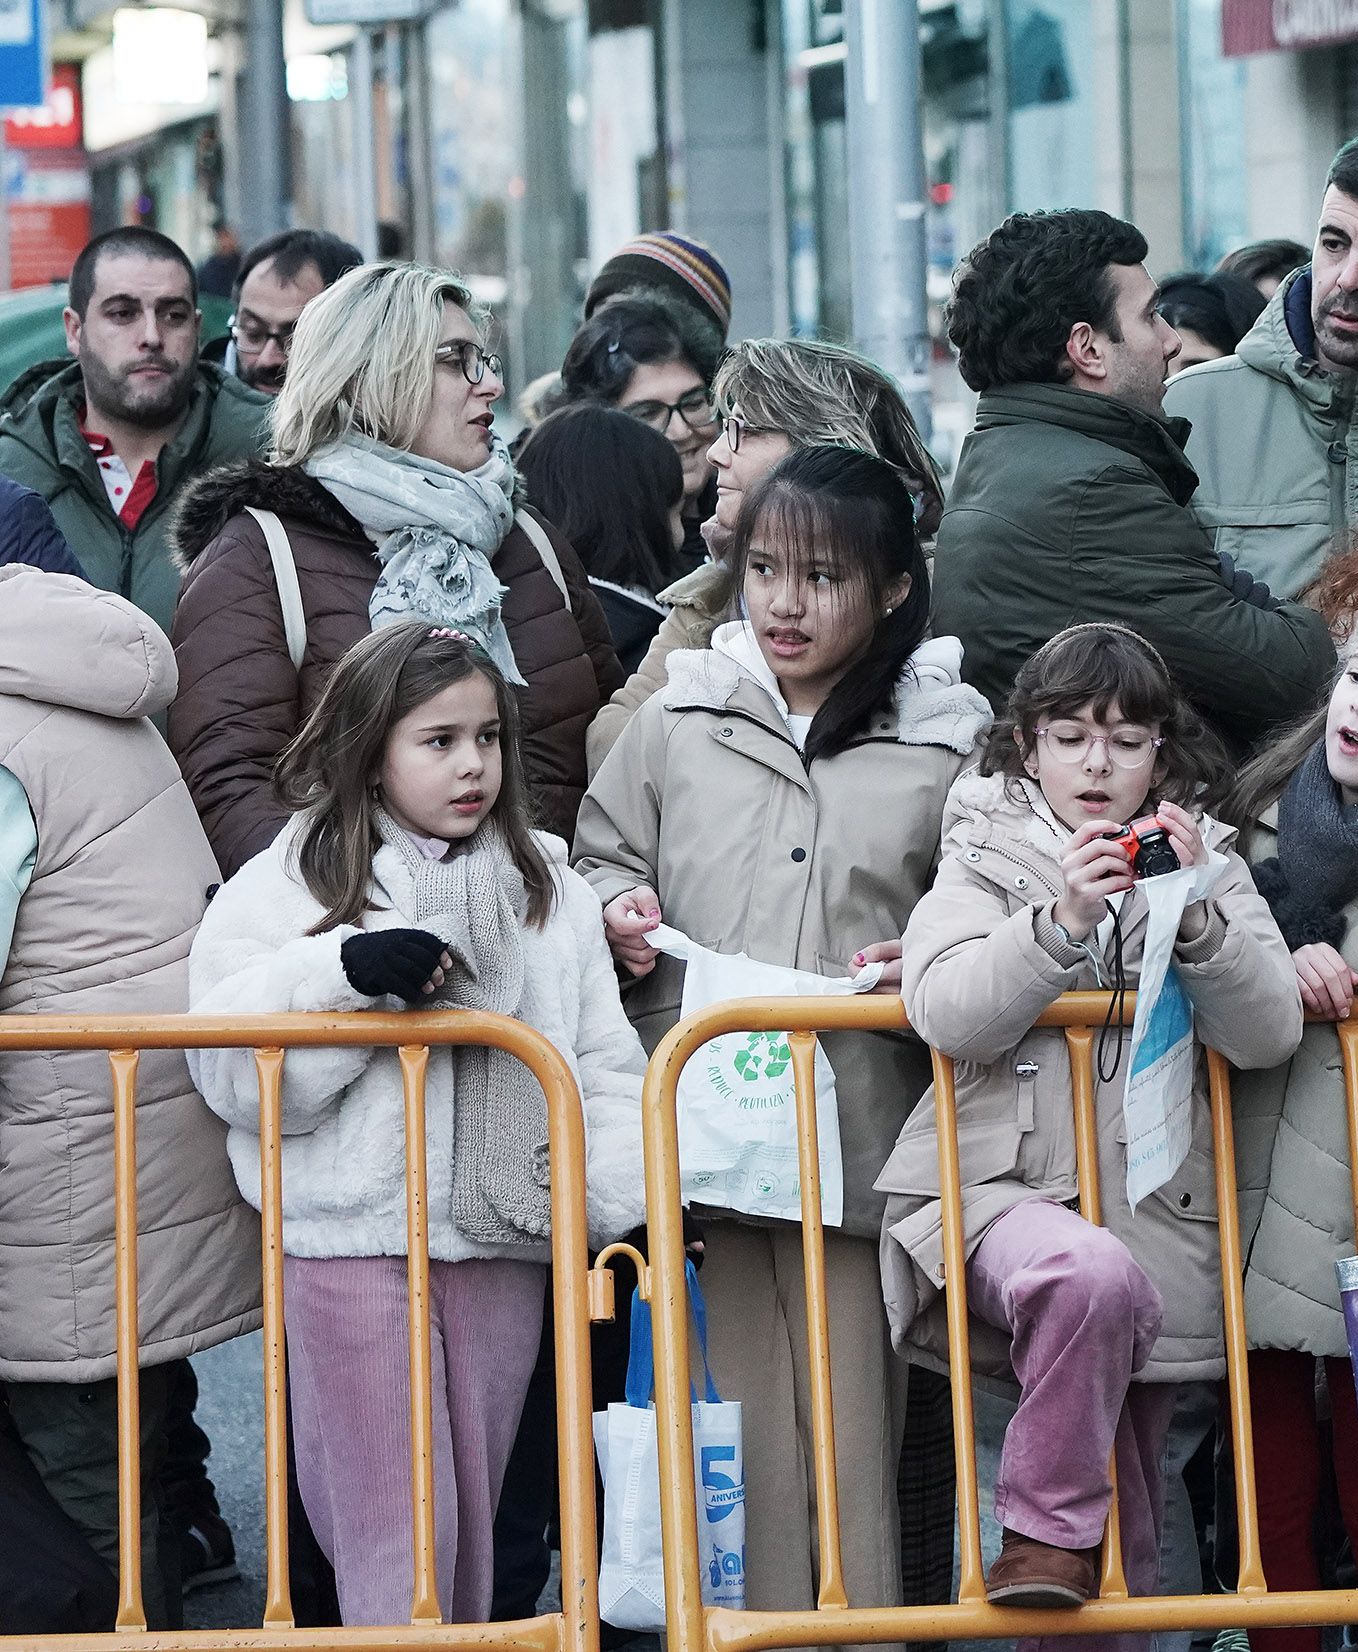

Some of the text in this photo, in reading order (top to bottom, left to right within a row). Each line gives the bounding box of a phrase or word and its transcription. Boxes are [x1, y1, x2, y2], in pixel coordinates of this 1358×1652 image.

[707, 1065, 735, 1100] REDUCE
[739, 1092, 785, 1110] REUTILIZA
[701, 1445, 745, 1524] 5
